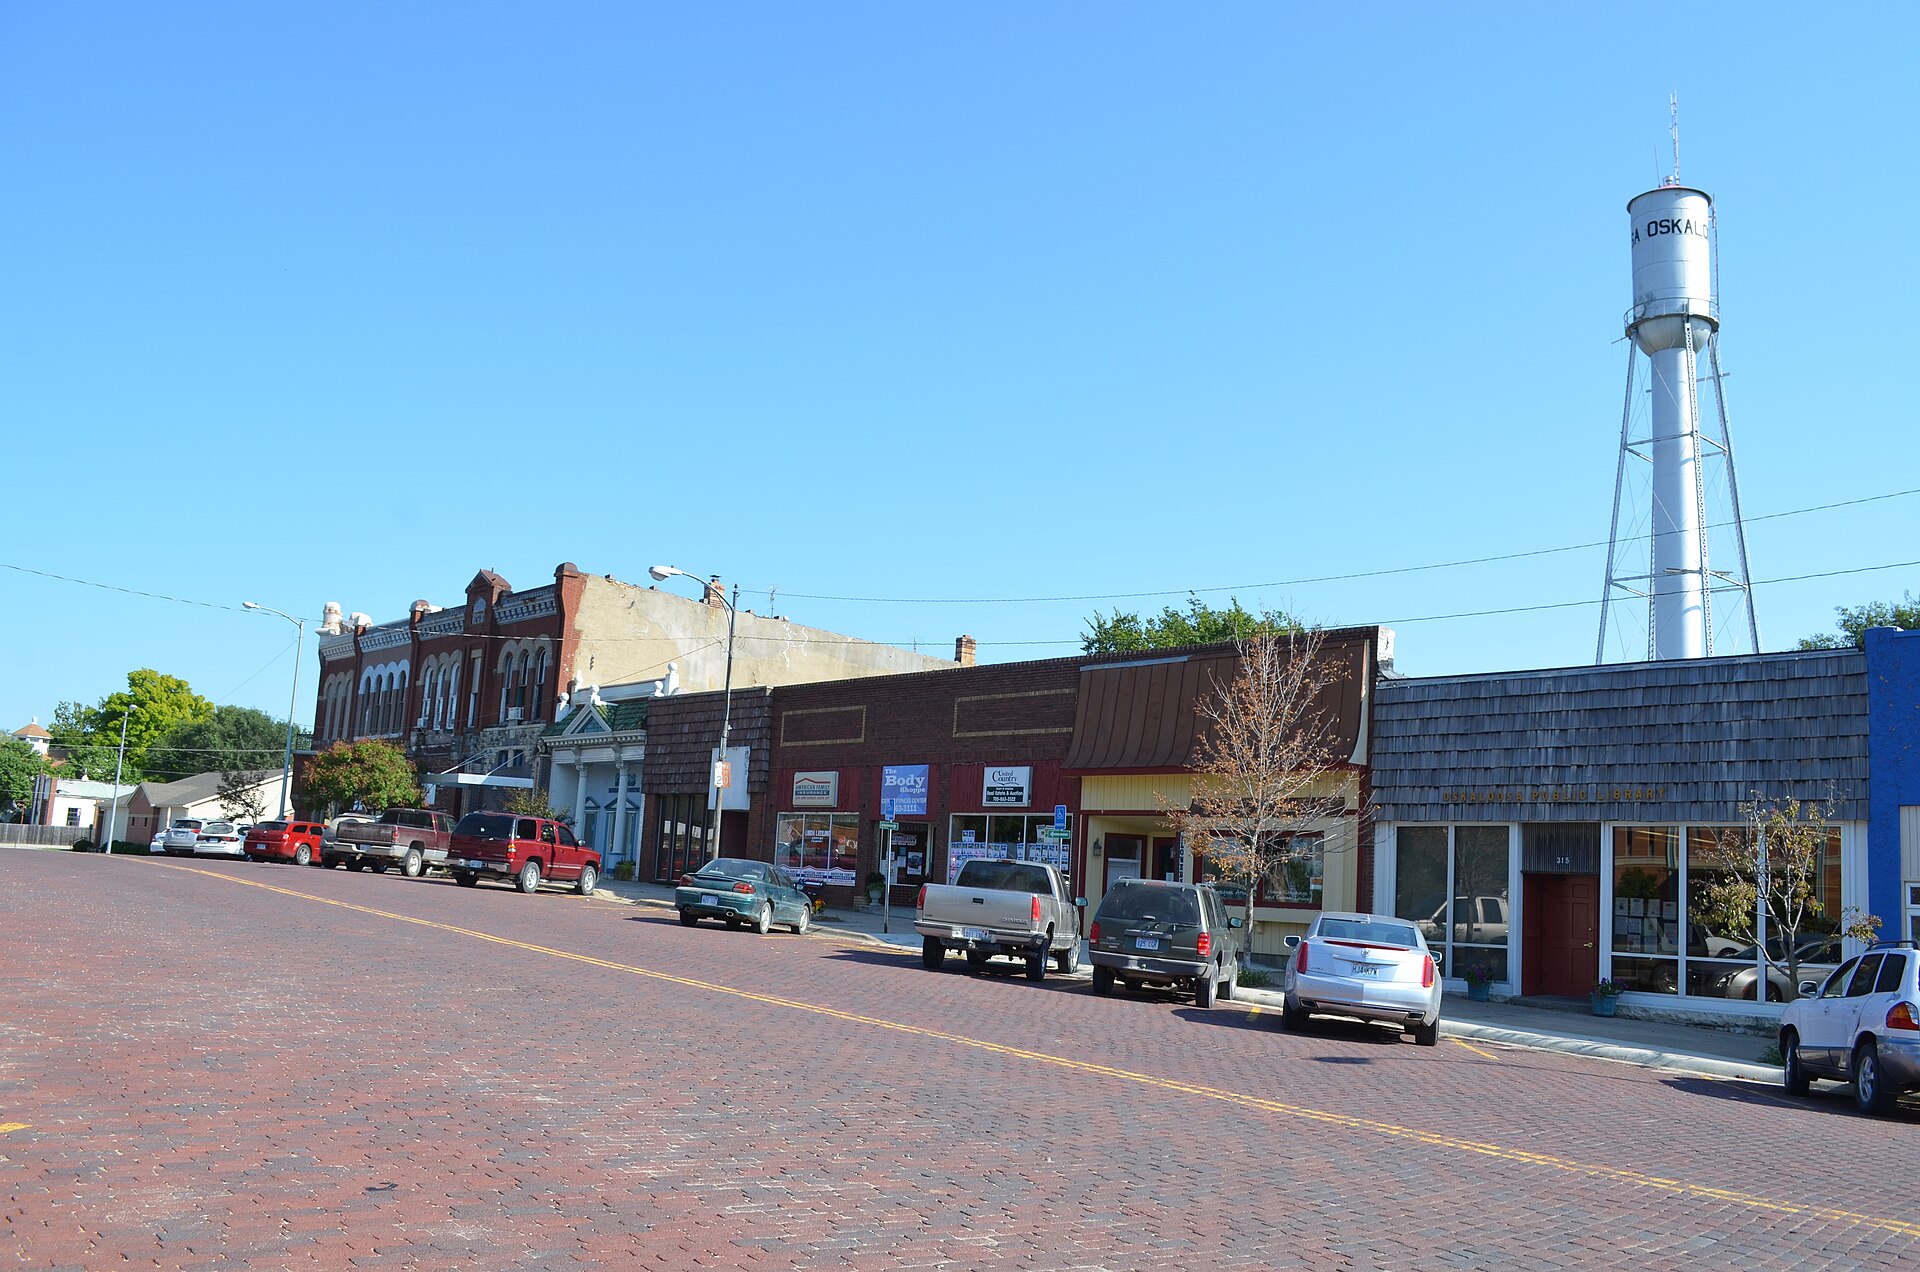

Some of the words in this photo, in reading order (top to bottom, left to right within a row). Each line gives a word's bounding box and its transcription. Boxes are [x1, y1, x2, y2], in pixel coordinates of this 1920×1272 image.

[885, 774, 925, 788] Body
[992, 770, 1017, 782] Country
[1443, 791, 1523, 801] OSKALOOSA
[1532, 790, 1587, 800] PUBLIC
[1597, 788, 1664, 800] LIBRARY
[1556, 856, 1570, 864] 315
